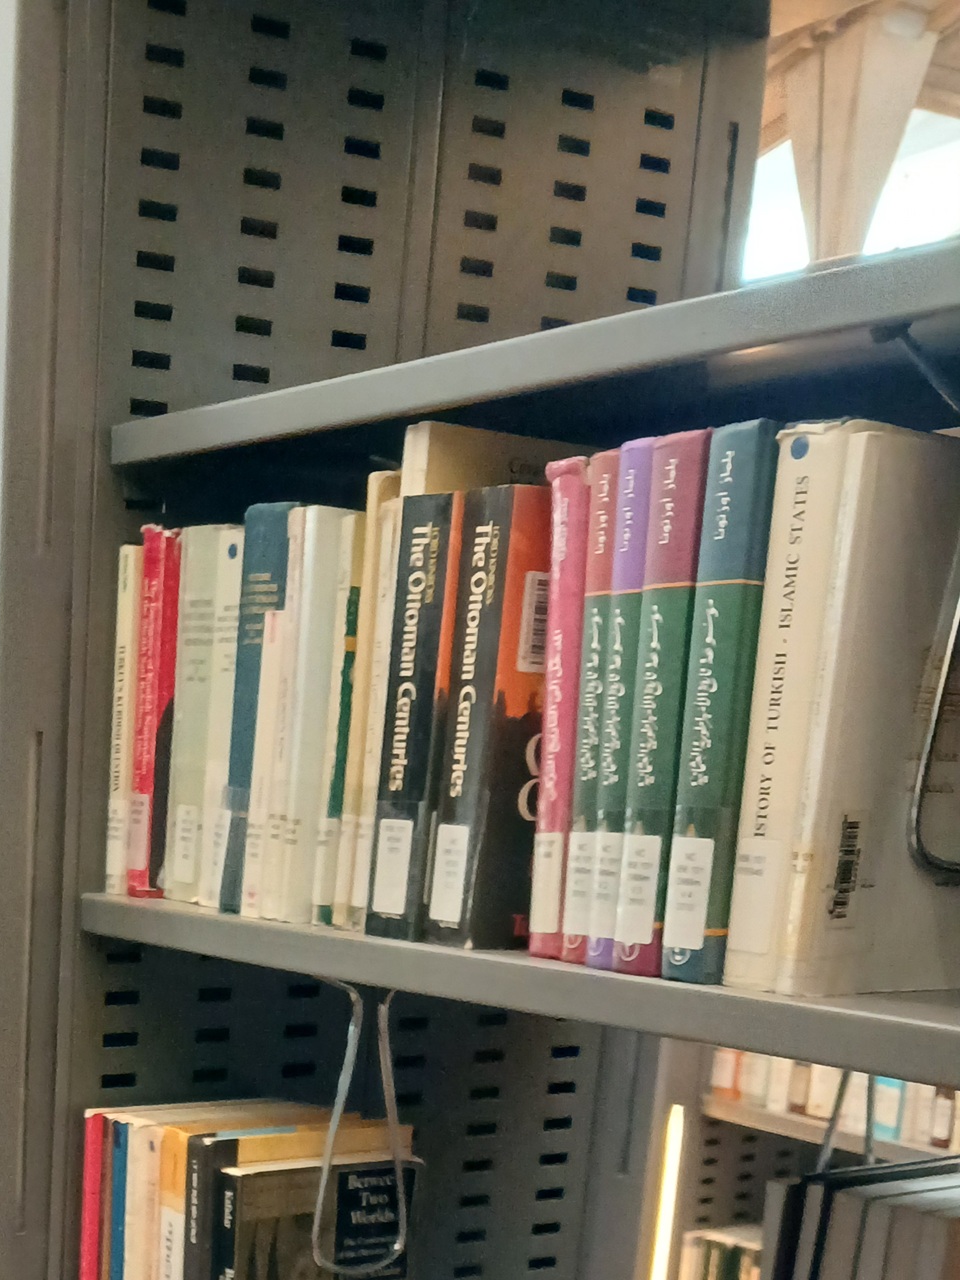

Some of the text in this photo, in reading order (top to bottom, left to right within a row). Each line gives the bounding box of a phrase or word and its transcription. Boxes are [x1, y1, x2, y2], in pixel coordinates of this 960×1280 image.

[411, 521, 434, 567] The
[789, 475, 810, 545] STATES
[400, 571, 426, 677] Ottoman
[778, 552, 801, 629] ISLAMIC
[451, 520, 495, 798] The Ottoman Centuries
[765, 651, 788, 733] TURKISH
[389, 681, 416, 792] Centuries
[761, 741, 777, 765] OF
[752, 774, 773, 838] ISTORY
